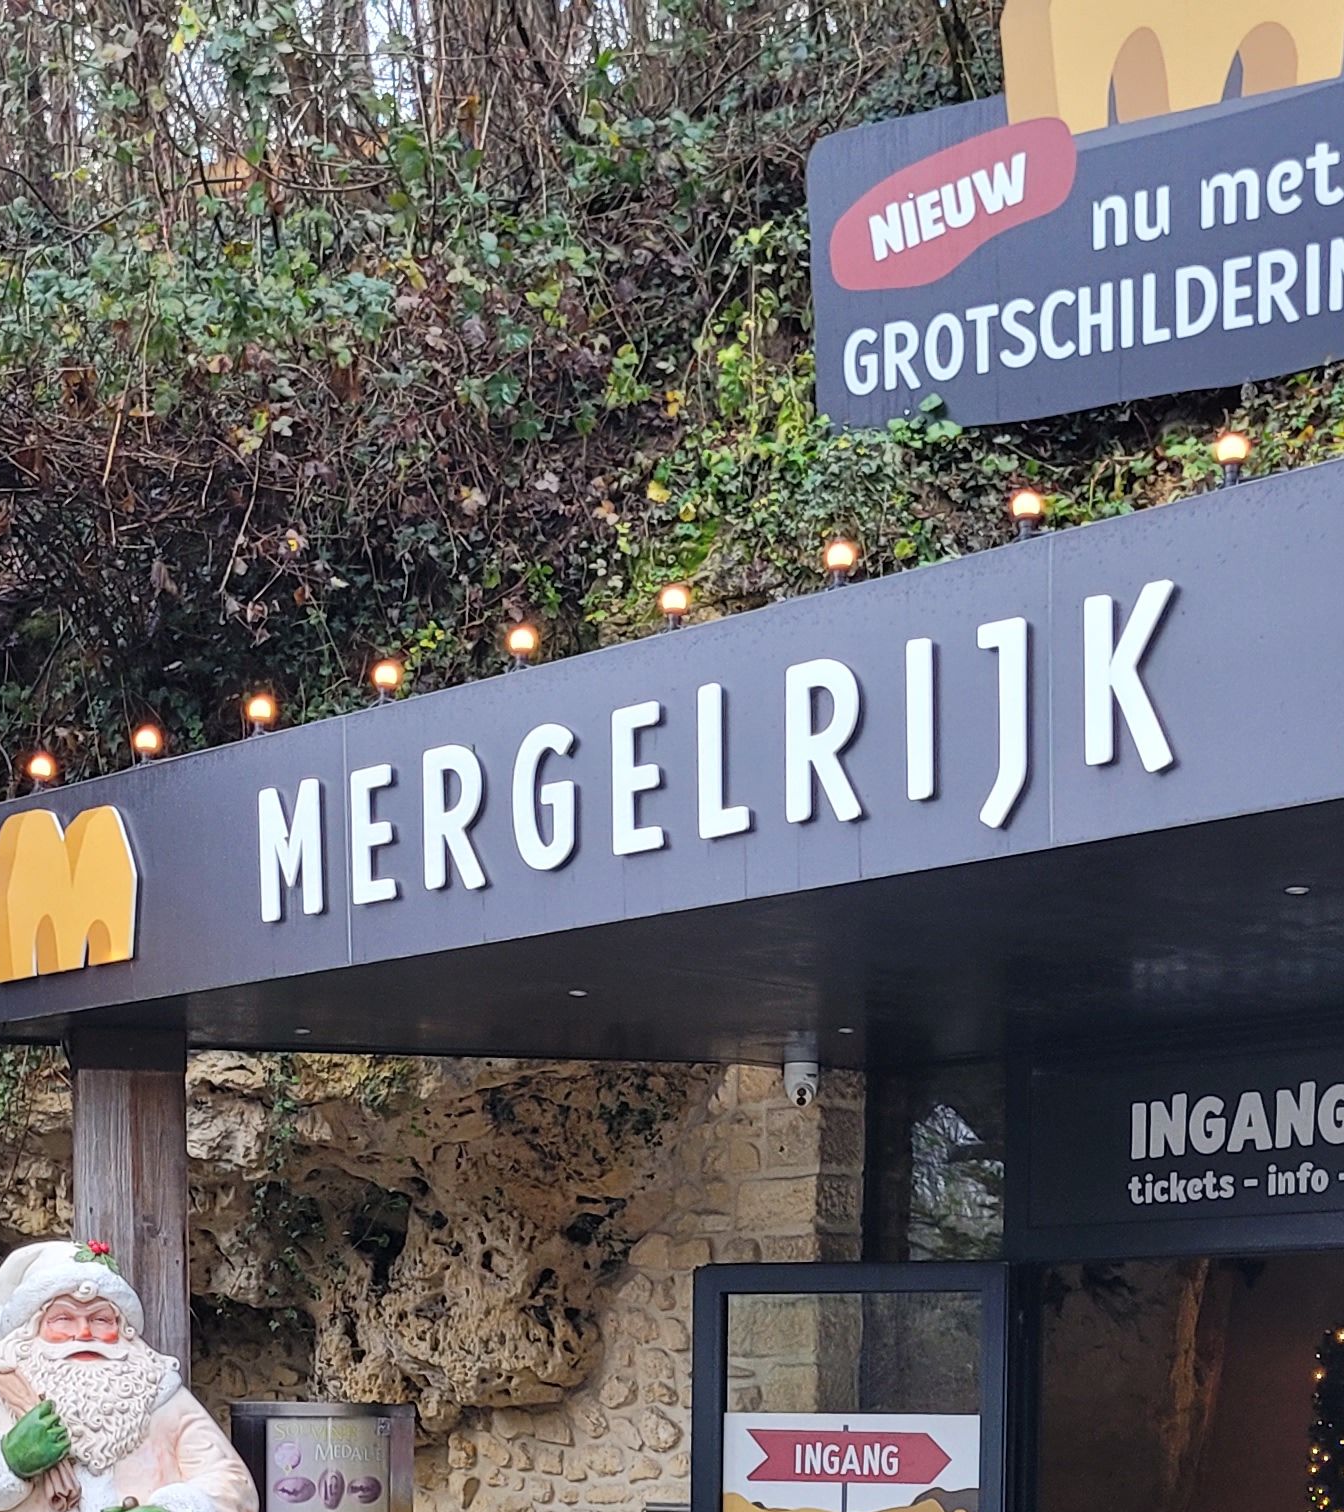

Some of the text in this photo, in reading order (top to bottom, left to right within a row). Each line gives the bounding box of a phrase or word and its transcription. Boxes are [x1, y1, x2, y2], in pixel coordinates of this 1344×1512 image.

[1092, 184, 1170, 251] nu
[1201, 142, 1344, 230] met
[258, 579, 1175, 923] MERGELRIJK
[1127, 1170, 1235, 1205] tickets
[1268, 1162, 1329, 1196] info
[315, 1442, 384, 1461] MEDAILE
[794, 1441, 899, 1477] INGANG
